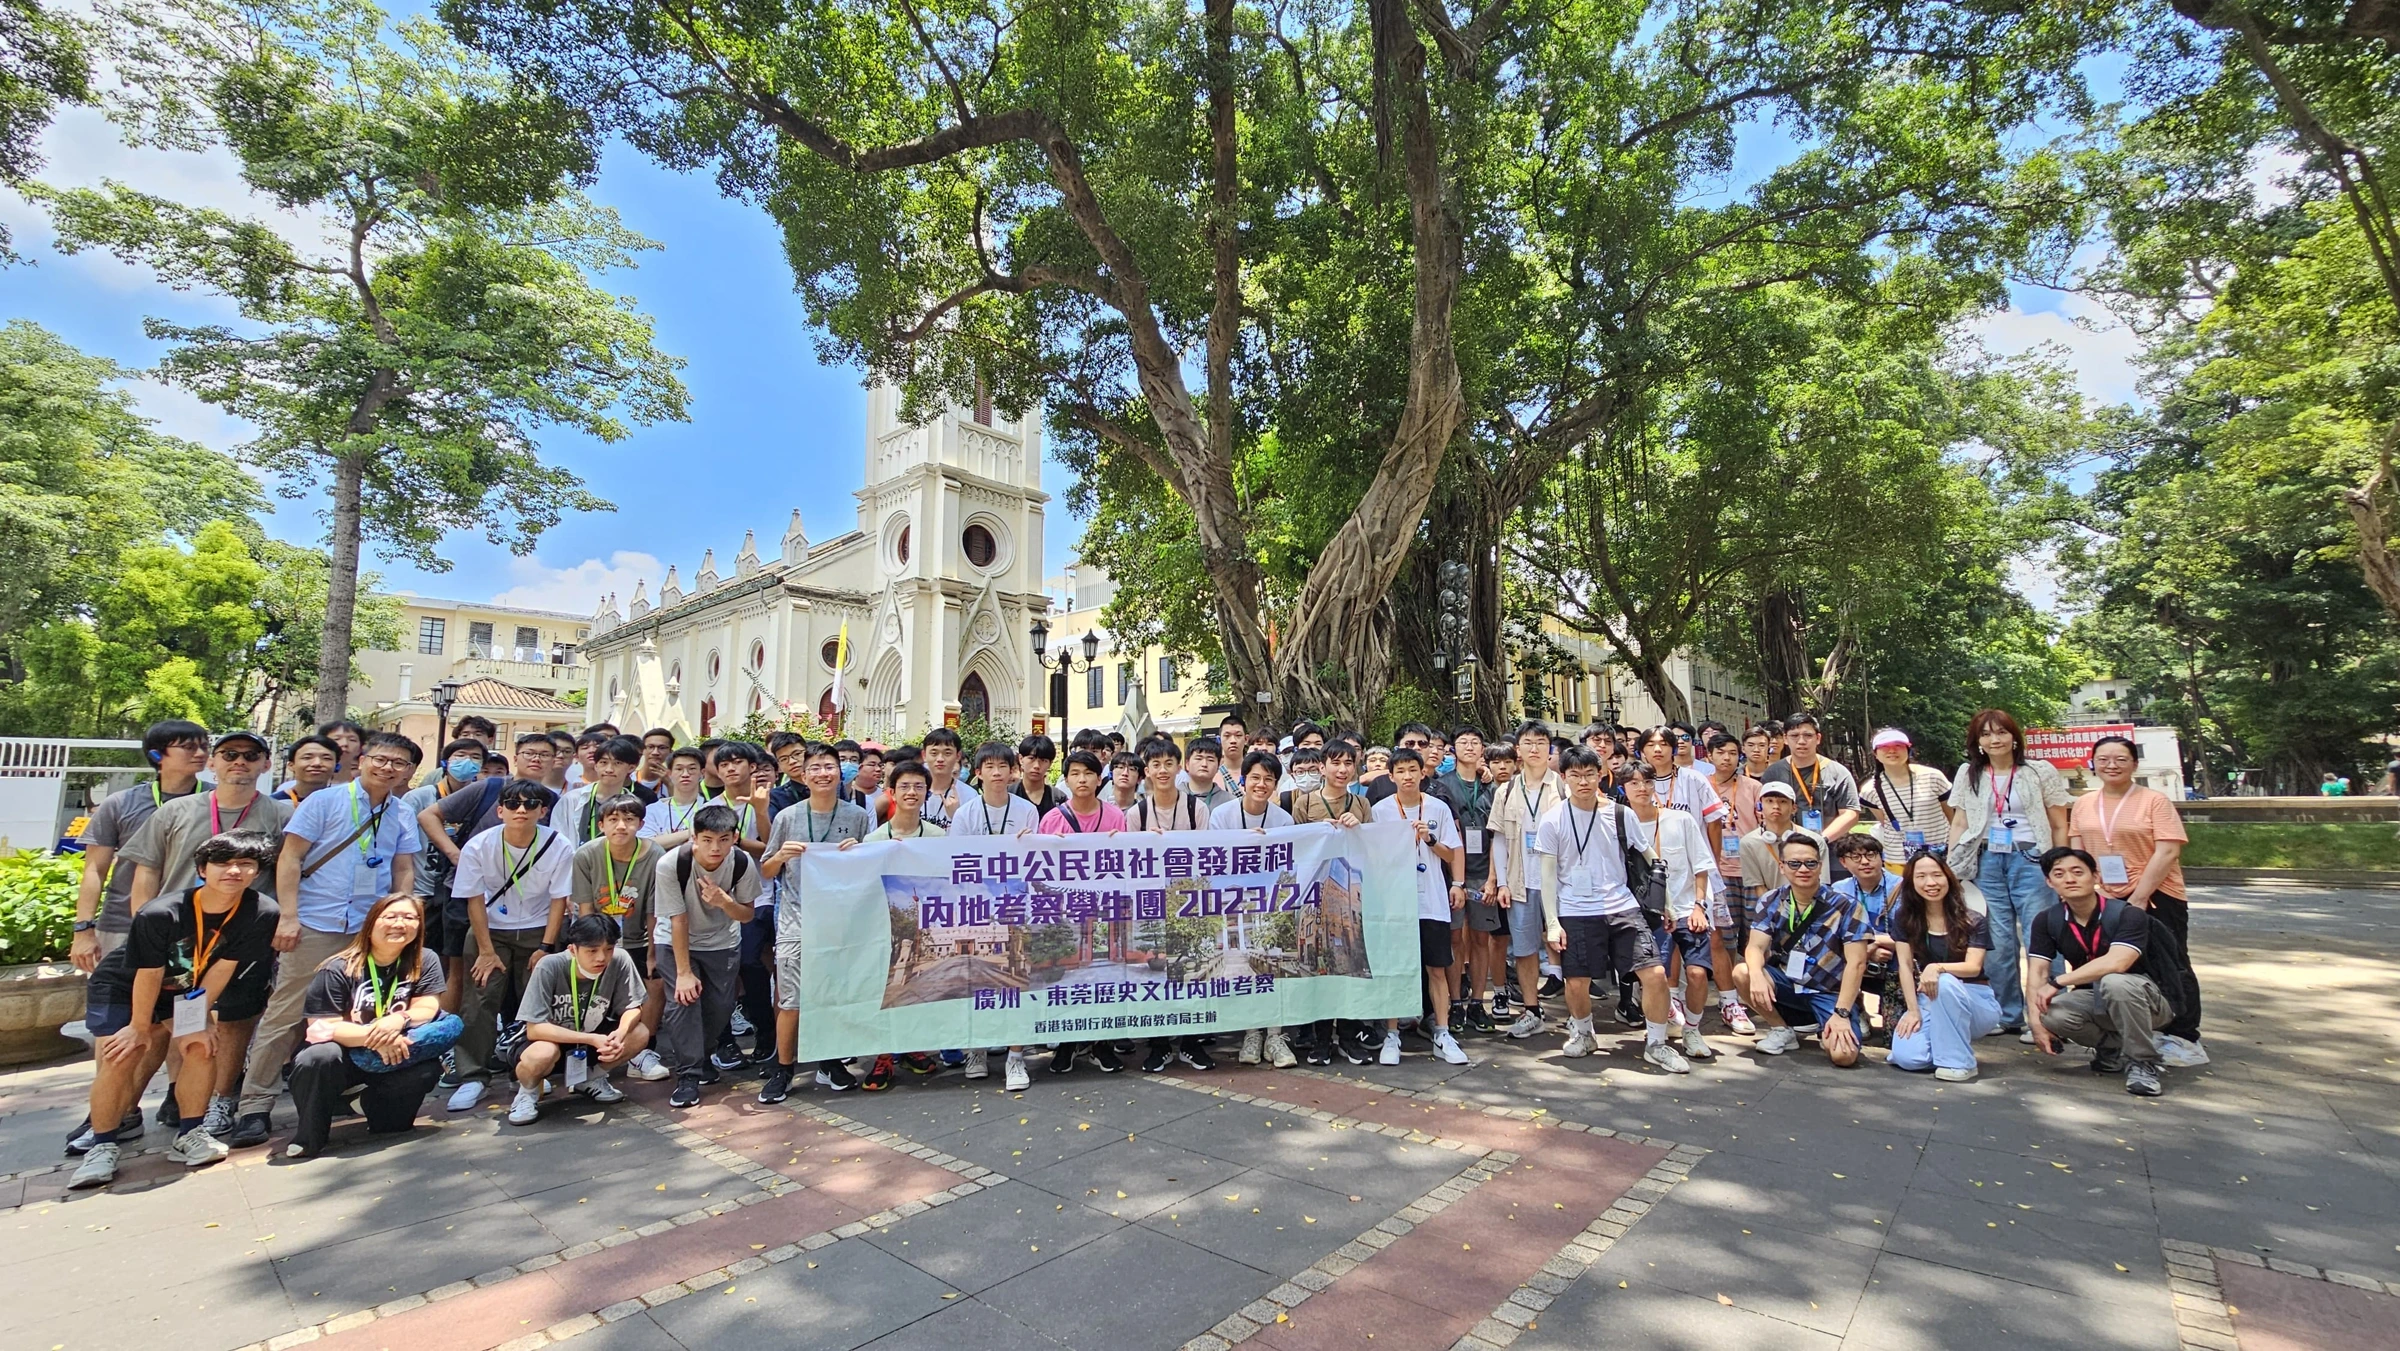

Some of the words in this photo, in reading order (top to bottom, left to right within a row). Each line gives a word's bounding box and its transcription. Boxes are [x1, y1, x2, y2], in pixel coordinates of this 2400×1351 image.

[951, 842, 1295, 885] 高中公民與社會發展科
[1179, 881, 1322, 917] 2023/24
[1034, 1010, 1217, 1034] 香港特別行政區政府教育局主辦
